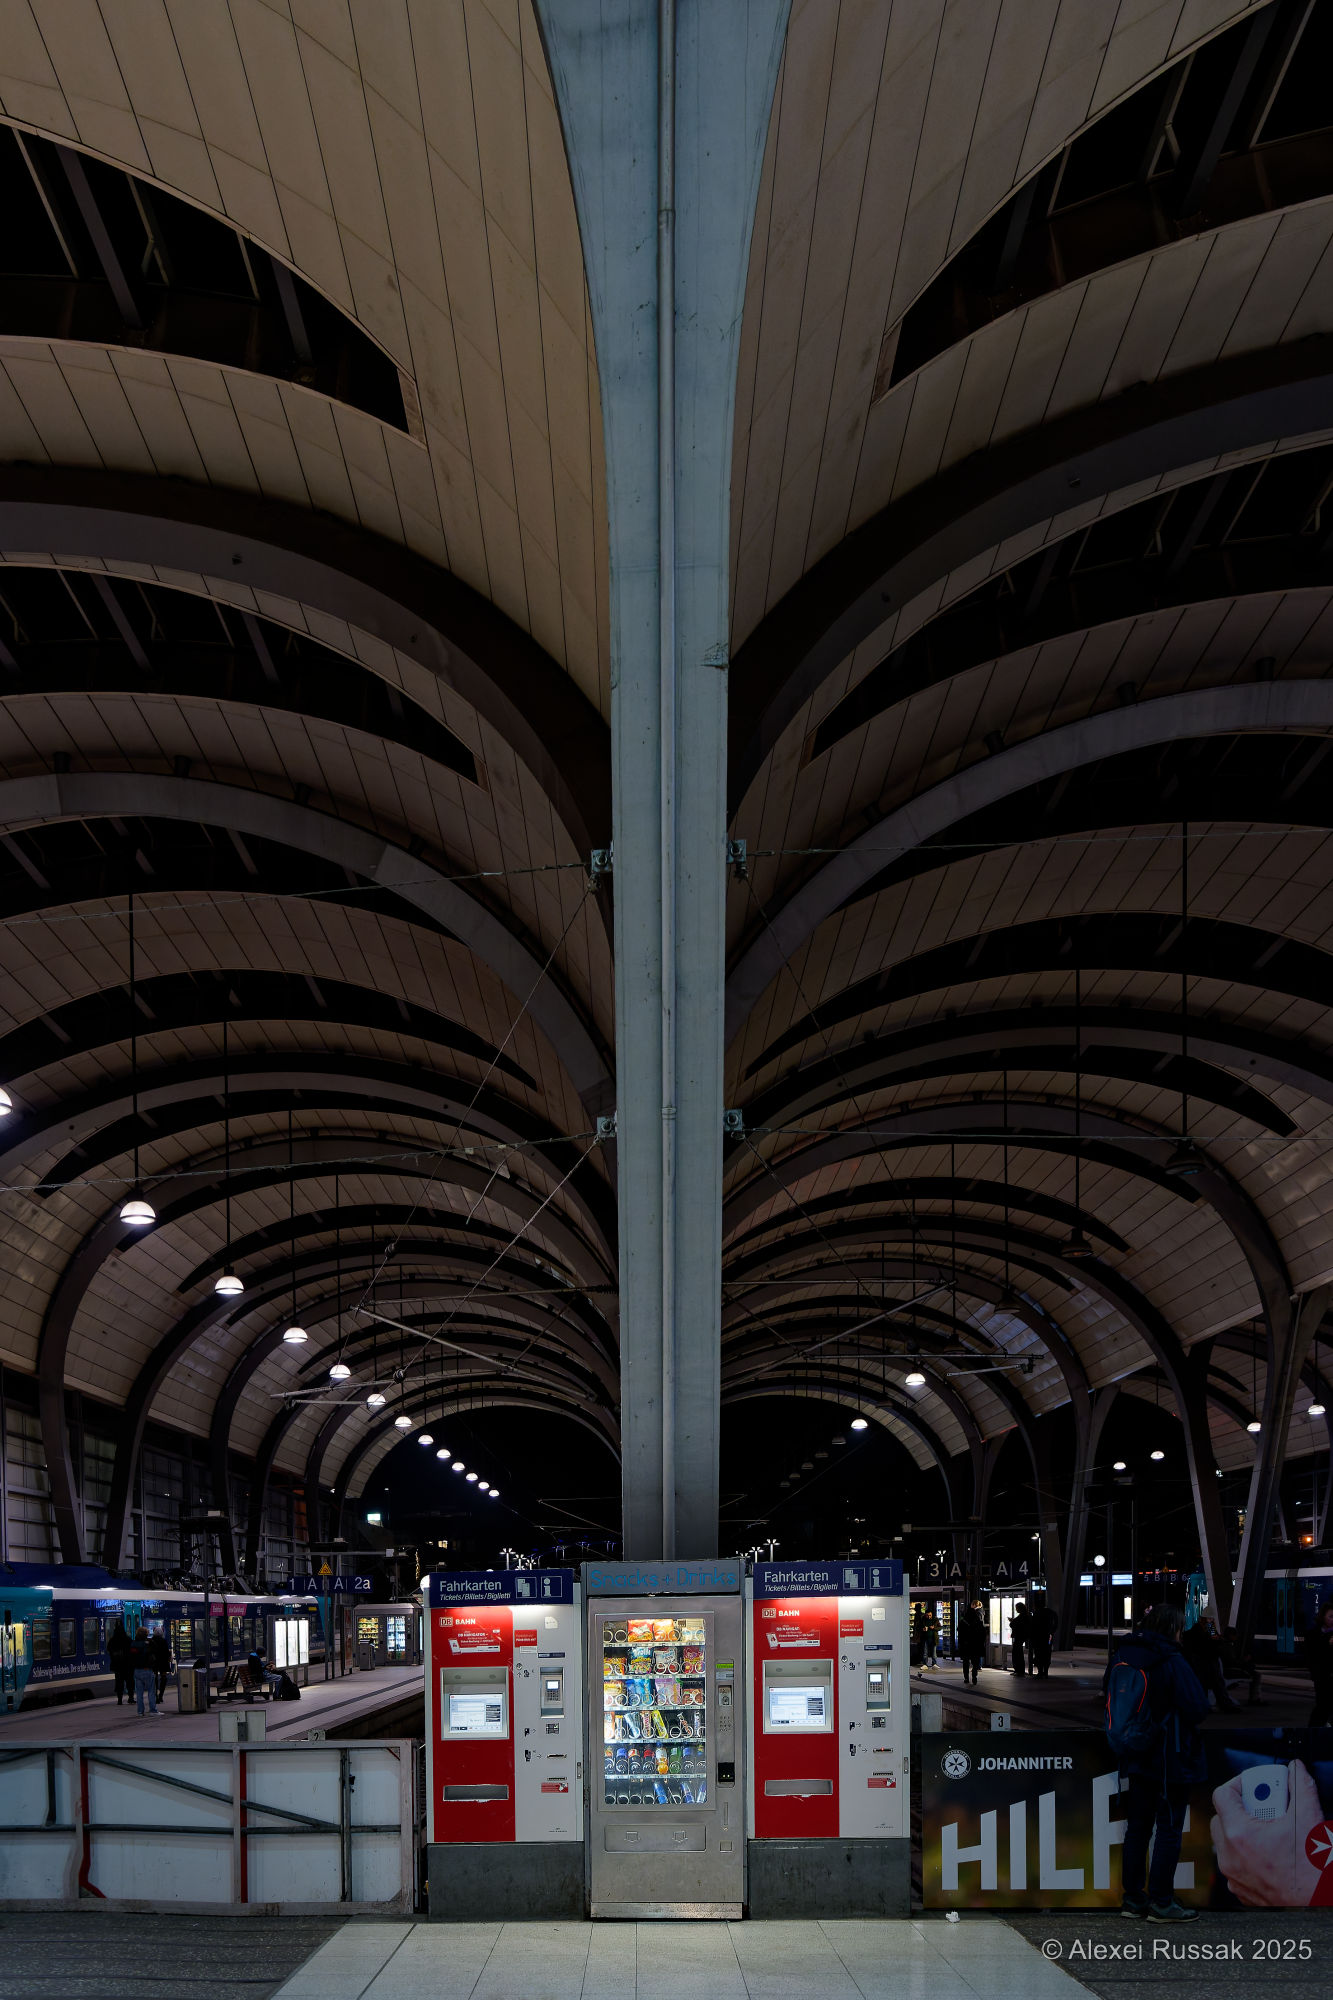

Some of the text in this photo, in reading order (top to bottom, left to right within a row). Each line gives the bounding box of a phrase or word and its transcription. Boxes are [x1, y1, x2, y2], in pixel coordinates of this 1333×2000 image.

[929, 1563, 962, 1577] 3 A
[996, 1560, 1029, 1576] A 4
[591, 1569, 659, 1588] Snacks
[677, 1568, 737, 1586] Drinks
[764, 1570, 829, 1583] Fahrkarten
[290, 1577, 318, 1590] 1 A
[333, 1577, 371, 1590] A 2a
[439, 1579, 503, 1592] Fahrkarten
[998, 1716, 1004, 1728] 3
[977, 1756, 1074, 1771] JOHANNITER
